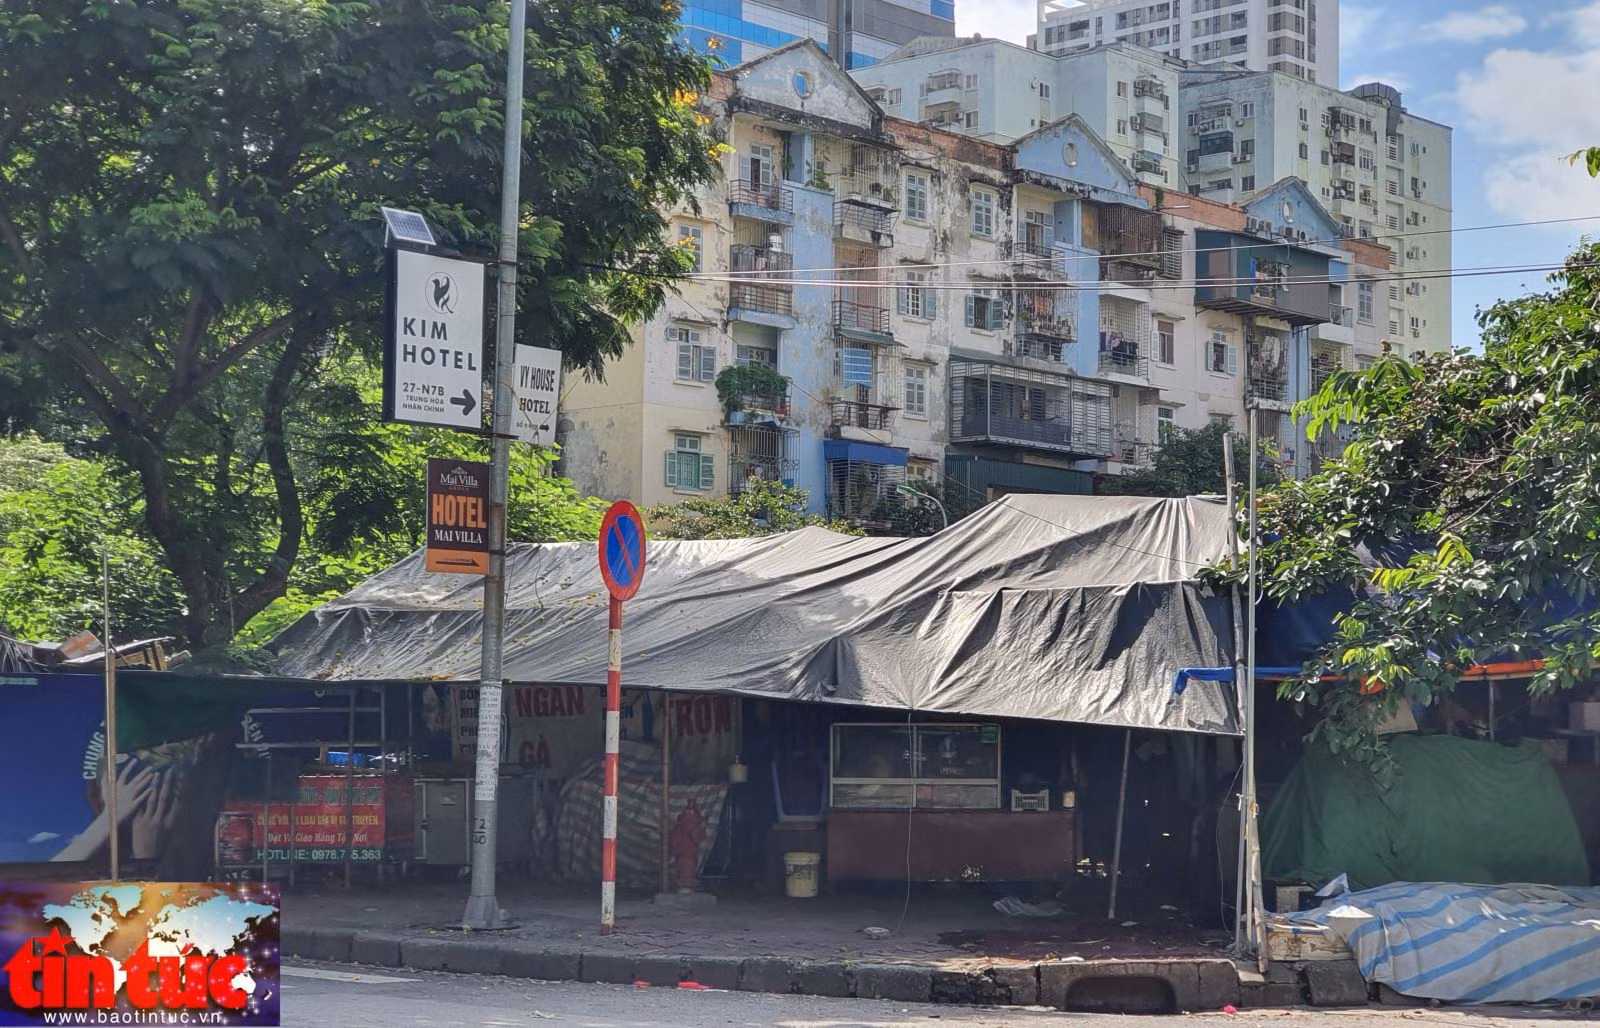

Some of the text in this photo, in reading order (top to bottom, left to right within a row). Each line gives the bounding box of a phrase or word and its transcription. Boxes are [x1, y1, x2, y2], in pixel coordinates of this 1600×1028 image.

[403, 316, 448, 341] KIM
[402, 344, 477, 372] HOTEL
[520, 365, 555, 392] VY HOUSE
[402, 382, 445, 396] 27-N7B
[402, 402, 422, 411] NHÂN
[406, 394, 428, 403] TRUNG
[519, 397, 550, 414] HOTEL
[440, 473, 478, 487] Mai Villa
[432, 493, 487, 529] HOTEL
[435, 529, 482, 544] MAI VILLA
[514, 686, 585, 717] NGAN
[518, 734, 552, 769] GÀ
[311, 849, 381, 861] 0978.75.363
